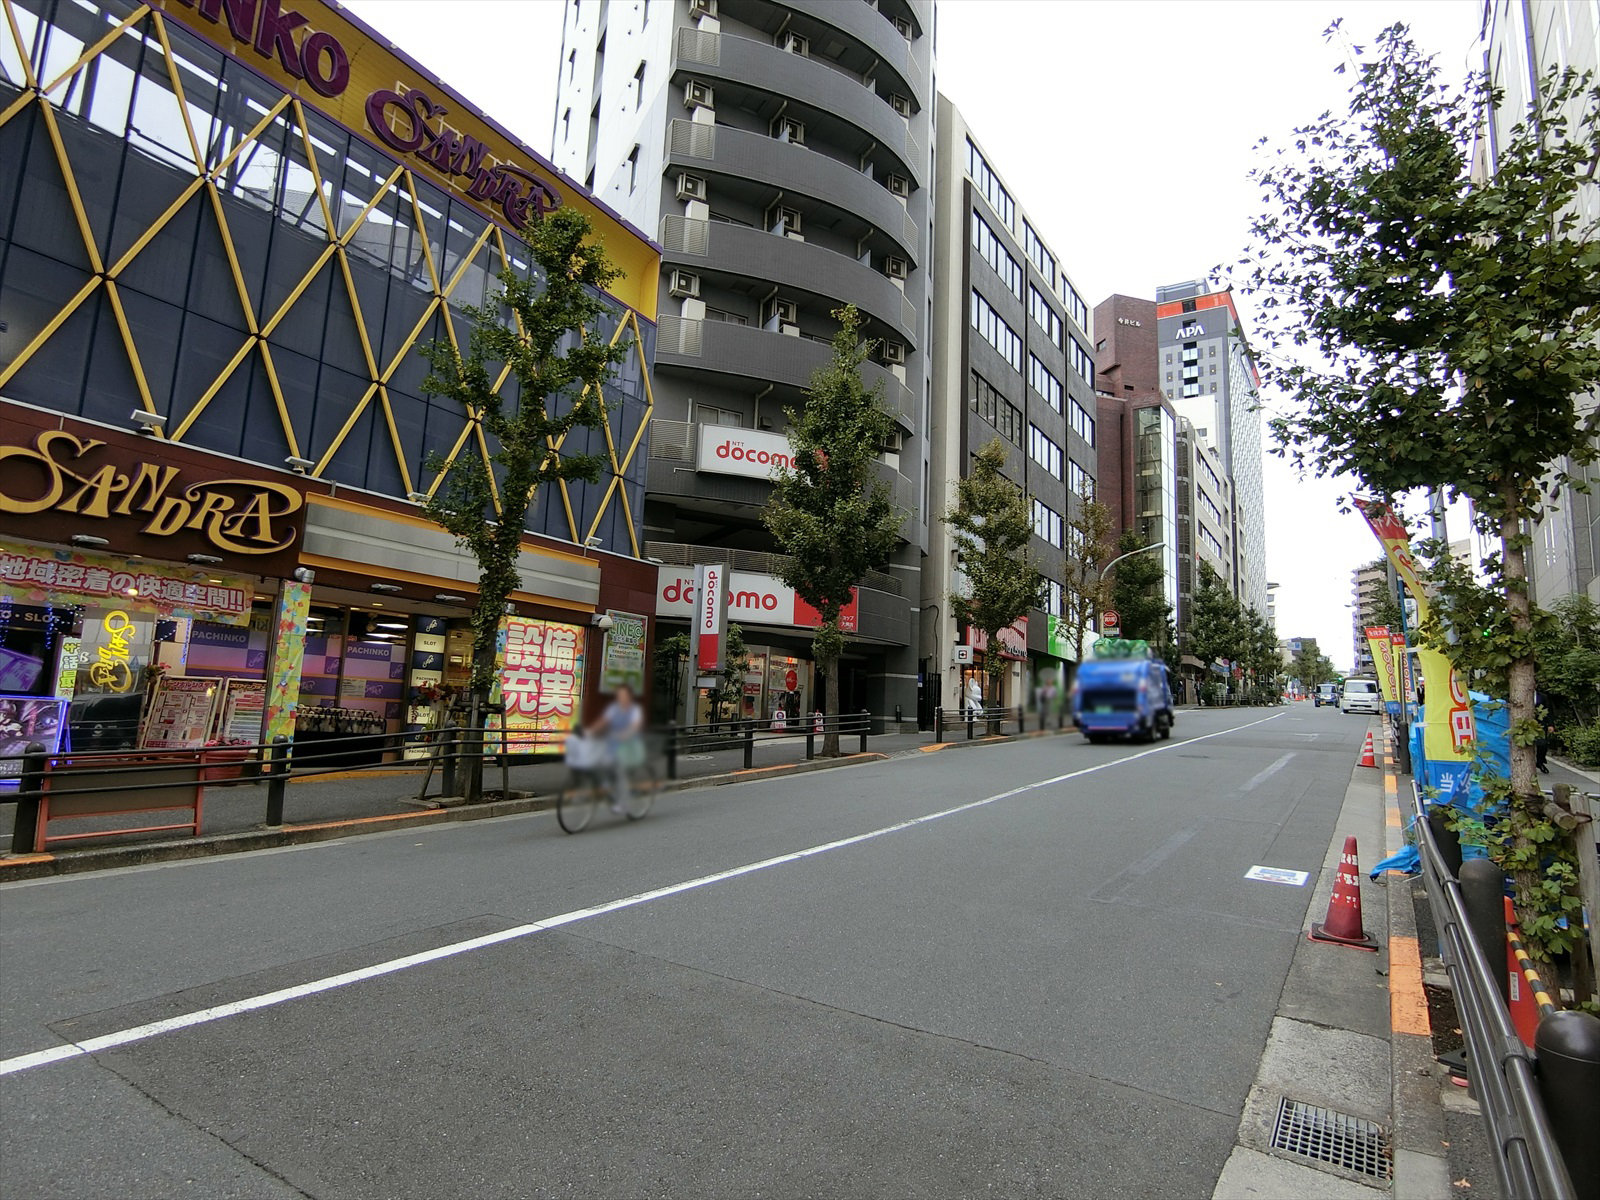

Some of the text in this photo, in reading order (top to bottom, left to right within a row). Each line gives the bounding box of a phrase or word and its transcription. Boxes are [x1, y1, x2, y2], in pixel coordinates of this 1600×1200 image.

[365, 88, 563, 232] SANDRA
[1175, 324, 1205, 340] APA
[0, 430, 303, 554] SANDRA
[705, 570, 718, 629] docomo
[90, 610, 136, 692] SANDRA
[192, 630, 247, 643] PACHINKO
[347, 646, 389, 656] PACHINKO
[507, 624, 576, 671] 設備
[503, 668, 574, 714] 充実
